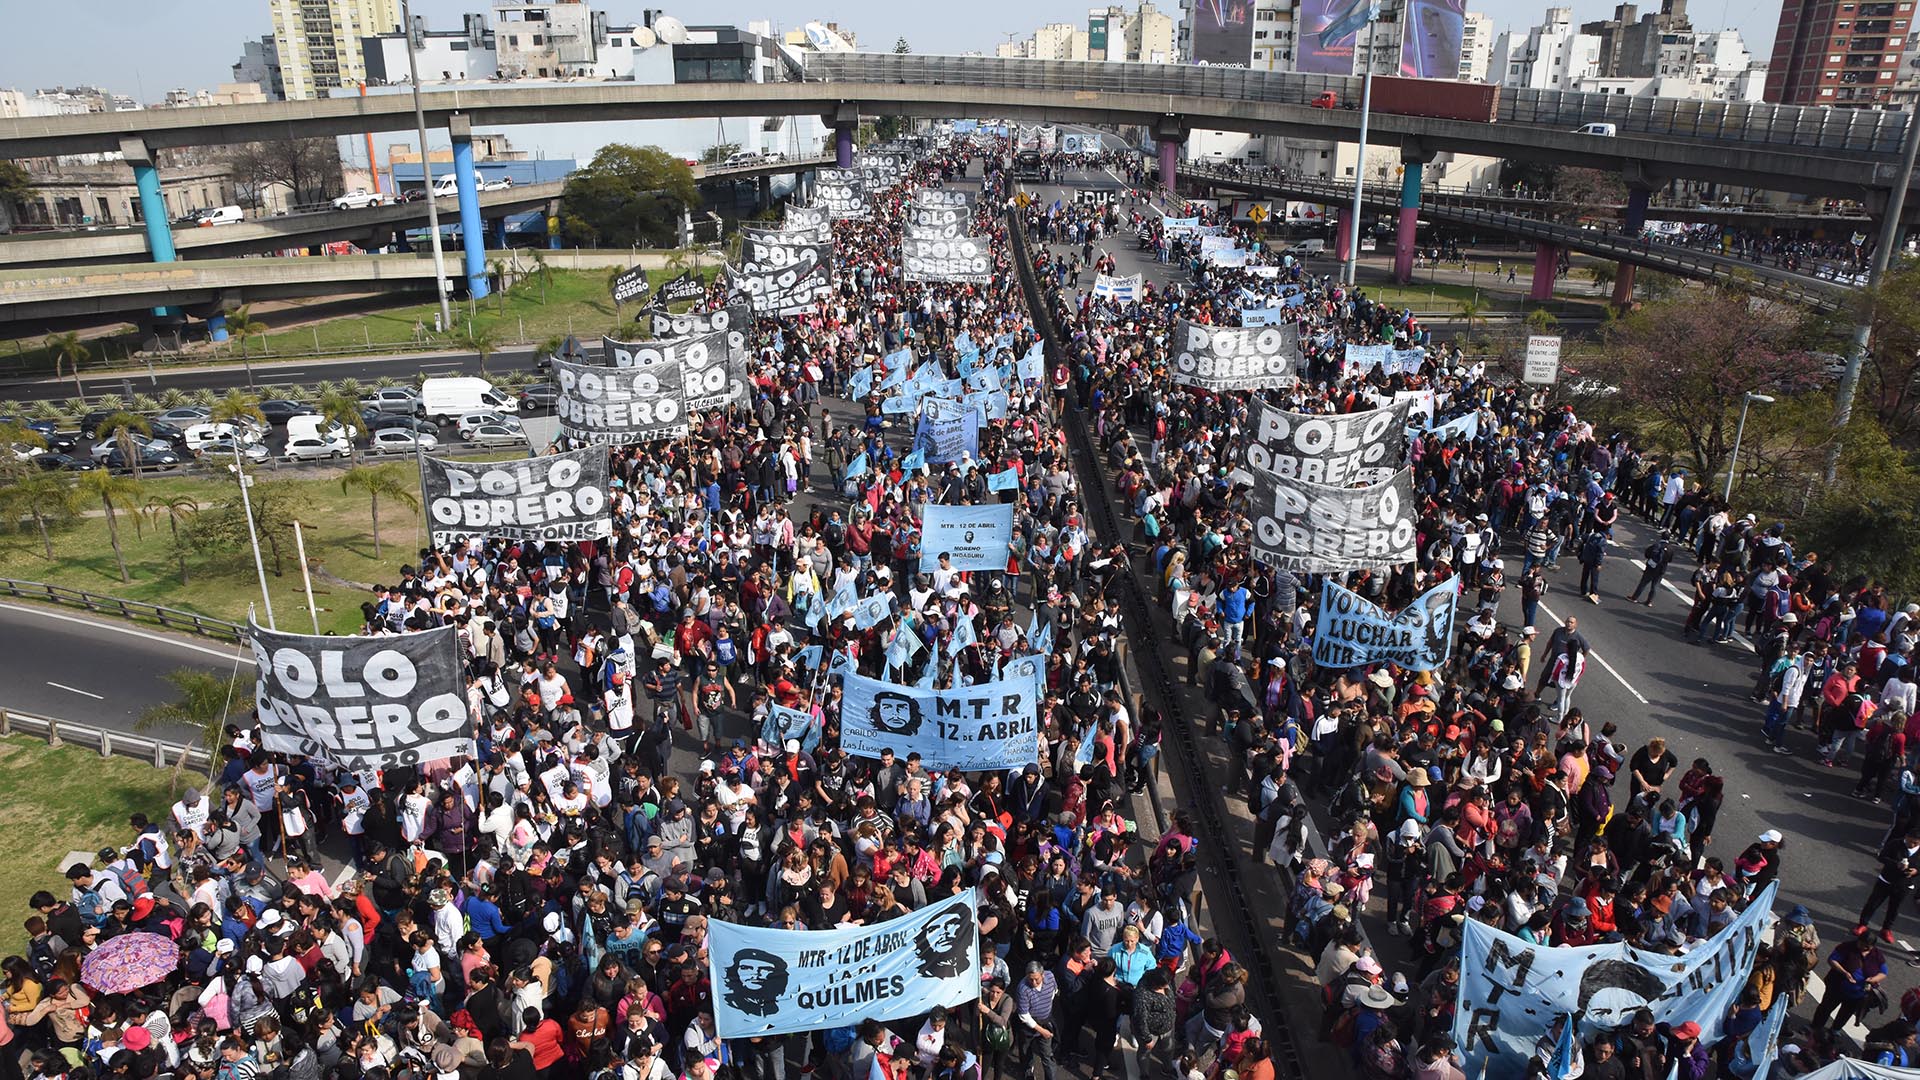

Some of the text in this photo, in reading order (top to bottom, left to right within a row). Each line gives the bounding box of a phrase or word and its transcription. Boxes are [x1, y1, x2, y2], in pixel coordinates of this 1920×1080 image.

[820, 169, 854, 180] POLO
[861, 156, 893, 167] POLO
[816, 184, 852, 200] POLO
[922, 191, 966, 206] POLO
[787, 209, 821, 225] POLO
[911, 208, 957, 225] POLO
[753, 243, 818, 267] POLO
[917, 241, 977, 259] POLO
[908, 257, 987, 273] OBRERO
[653, 310, 730, 337] POLO
[1187, 326, 1281, 357] POLO
[1178, 352, 1287, 377] OBRERO
[559, 368, 659, 401] POLO
[558, 394, 678, 427] OBRERO
[1258, 407, 1394, 456] POLO
[1247, 442, 1386, 485] OBRERO
[445, 459, 581, 497] POLO
[431, 486, 604, 527] OBRERO
[1274, 485, 1399, 525] POLO
[1257, 516, 1413, 557] OBRERO
[1254, 549, 1313, 571] LOMAS
[1329, 618, 1413, 647] LUCHAR
[1316, 637, 1355, 664] MTR
[250, 637, 417, 699] POLO
[256, 680, 467, 750] OBRERO
[843, 728, 878, 738] CABILDO
[937, 716, 1034, 742] 12 DE ABRIL
[381, 749, 420, 770] 20
[798, 930, 907, 968] MTR 12 DE ABRIL
[797, 974, 905, 1011] QUILMES
